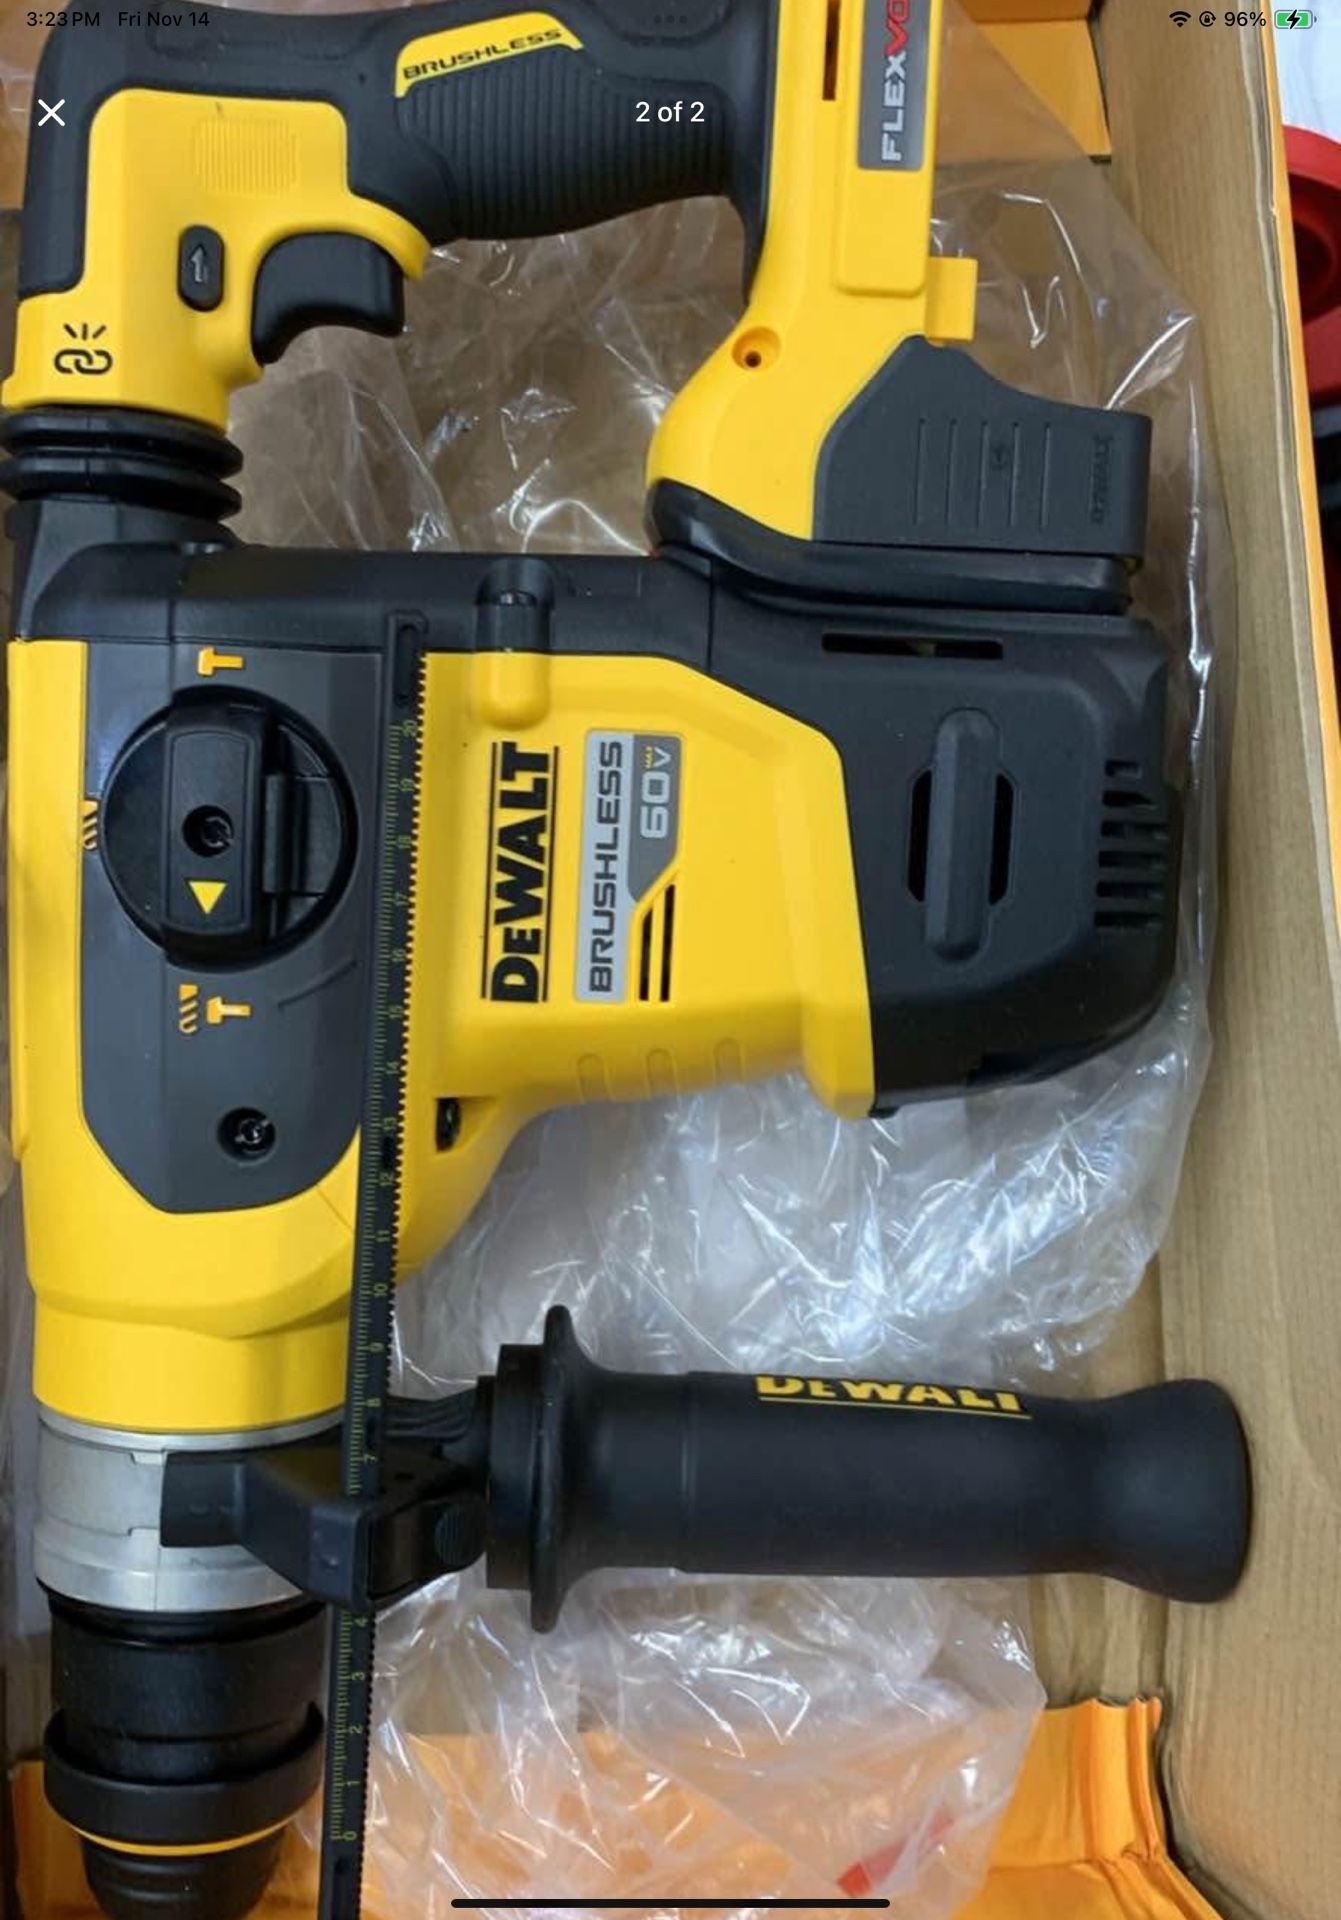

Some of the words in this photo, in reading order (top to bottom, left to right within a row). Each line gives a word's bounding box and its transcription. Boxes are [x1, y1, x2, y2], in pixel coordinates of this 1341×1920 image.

[403, 30, 561, 79] BRUSHLESS
[402, 720, 418, 737] 20
[400, 778, 415, 792] 19
[640, 747, 671, 839] 60V
[490, 741, 550, 1003] DEWALT
[589, 741, 622, 993] BRUSHLESS
[394, 892, 409, 906] 17
[386, 1061, 400, 1075] 14
[379, 1173, 394, 1187] 12
[376, 1230, 390, 1243] 11
[373, 1284, 388, 1297] 10
[370, 1342, 384, 1353] 9
[366, 1398, 381, 1408] 8
[363, 1453, 378, 1464] 7
[351, 1672, 366, 1682] 3
[348, 1725, 363, 1735] 2
[342, 1831, 357, 1842] 0
